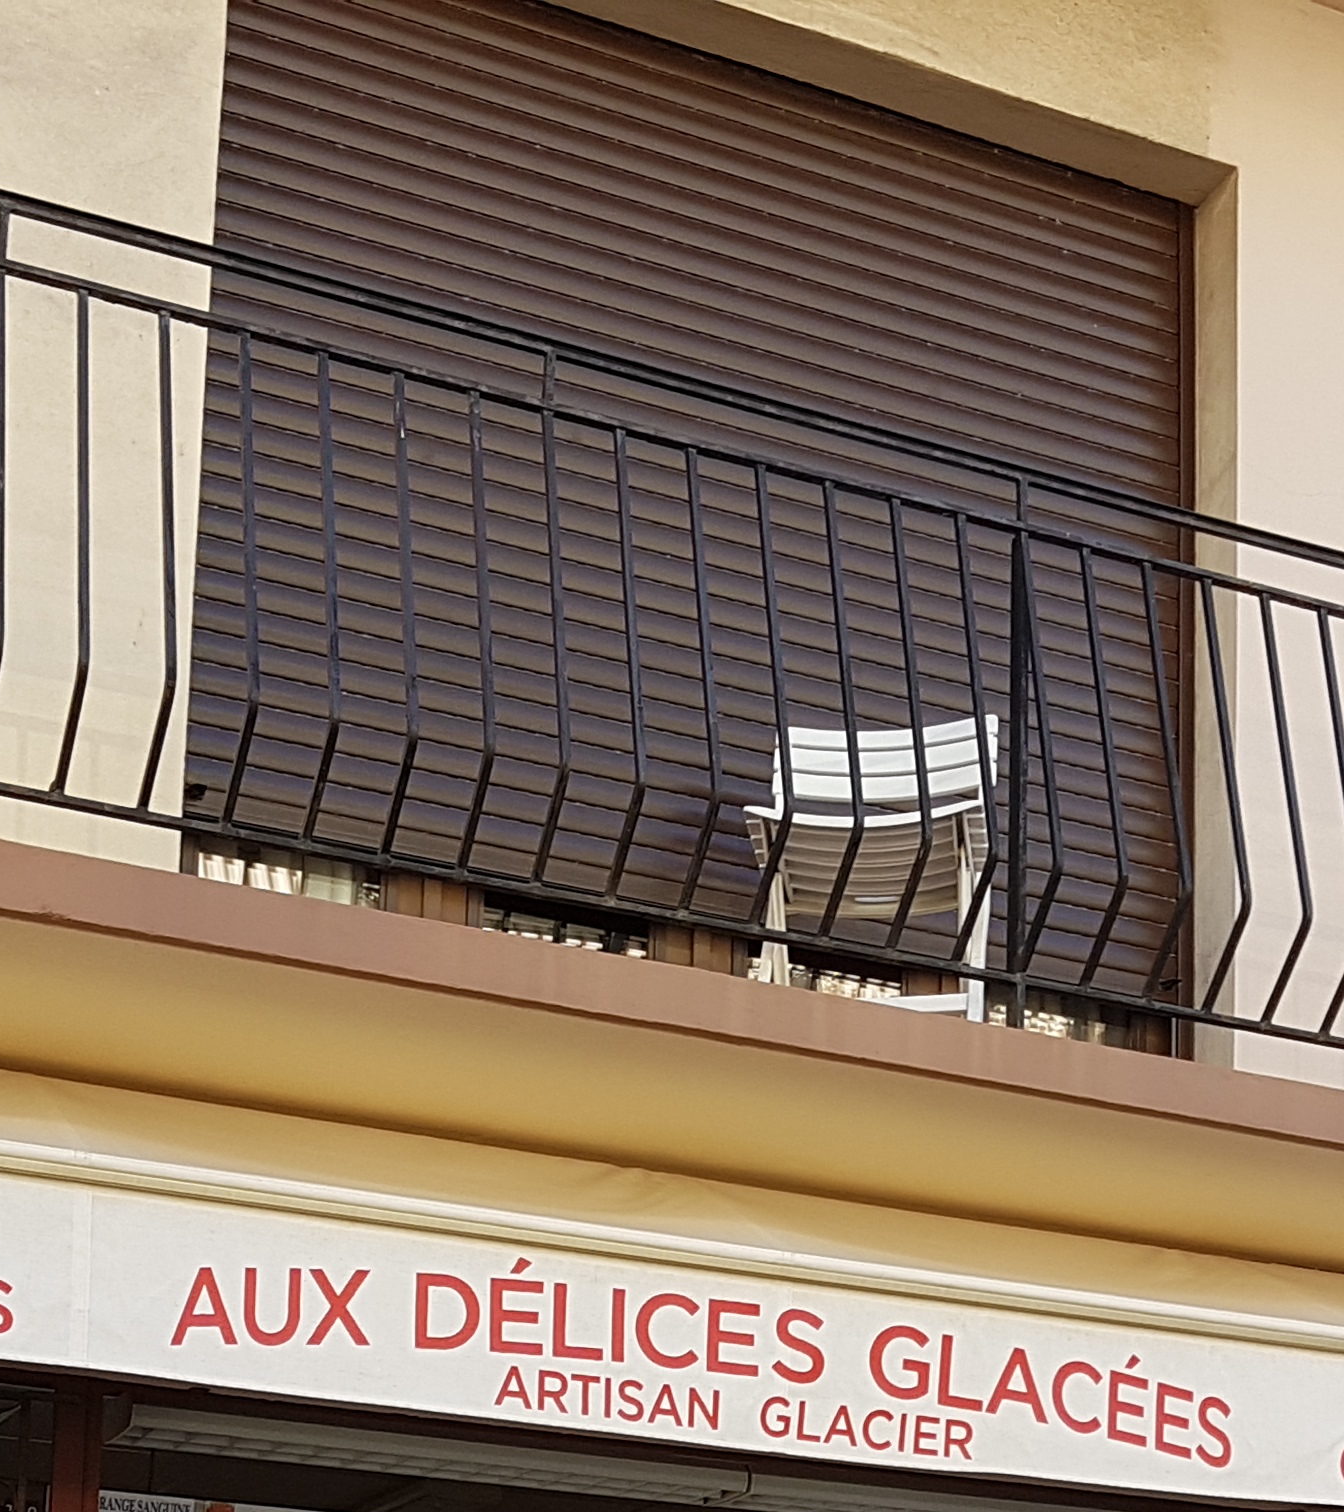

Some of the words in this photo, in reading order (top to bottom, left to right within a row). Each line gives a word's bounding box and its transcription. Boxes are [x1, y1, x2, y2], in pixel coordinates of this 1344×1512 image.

[171, 1267, 371, 1346] AUX
[415, 1257, 825, 1384] DÉLICES
[869, 1325, 1232, 1468] GLACÉES
[495, 1366, 720, 1431] ARTISAN
[760, 1396, 974, 1460] GLACIER
